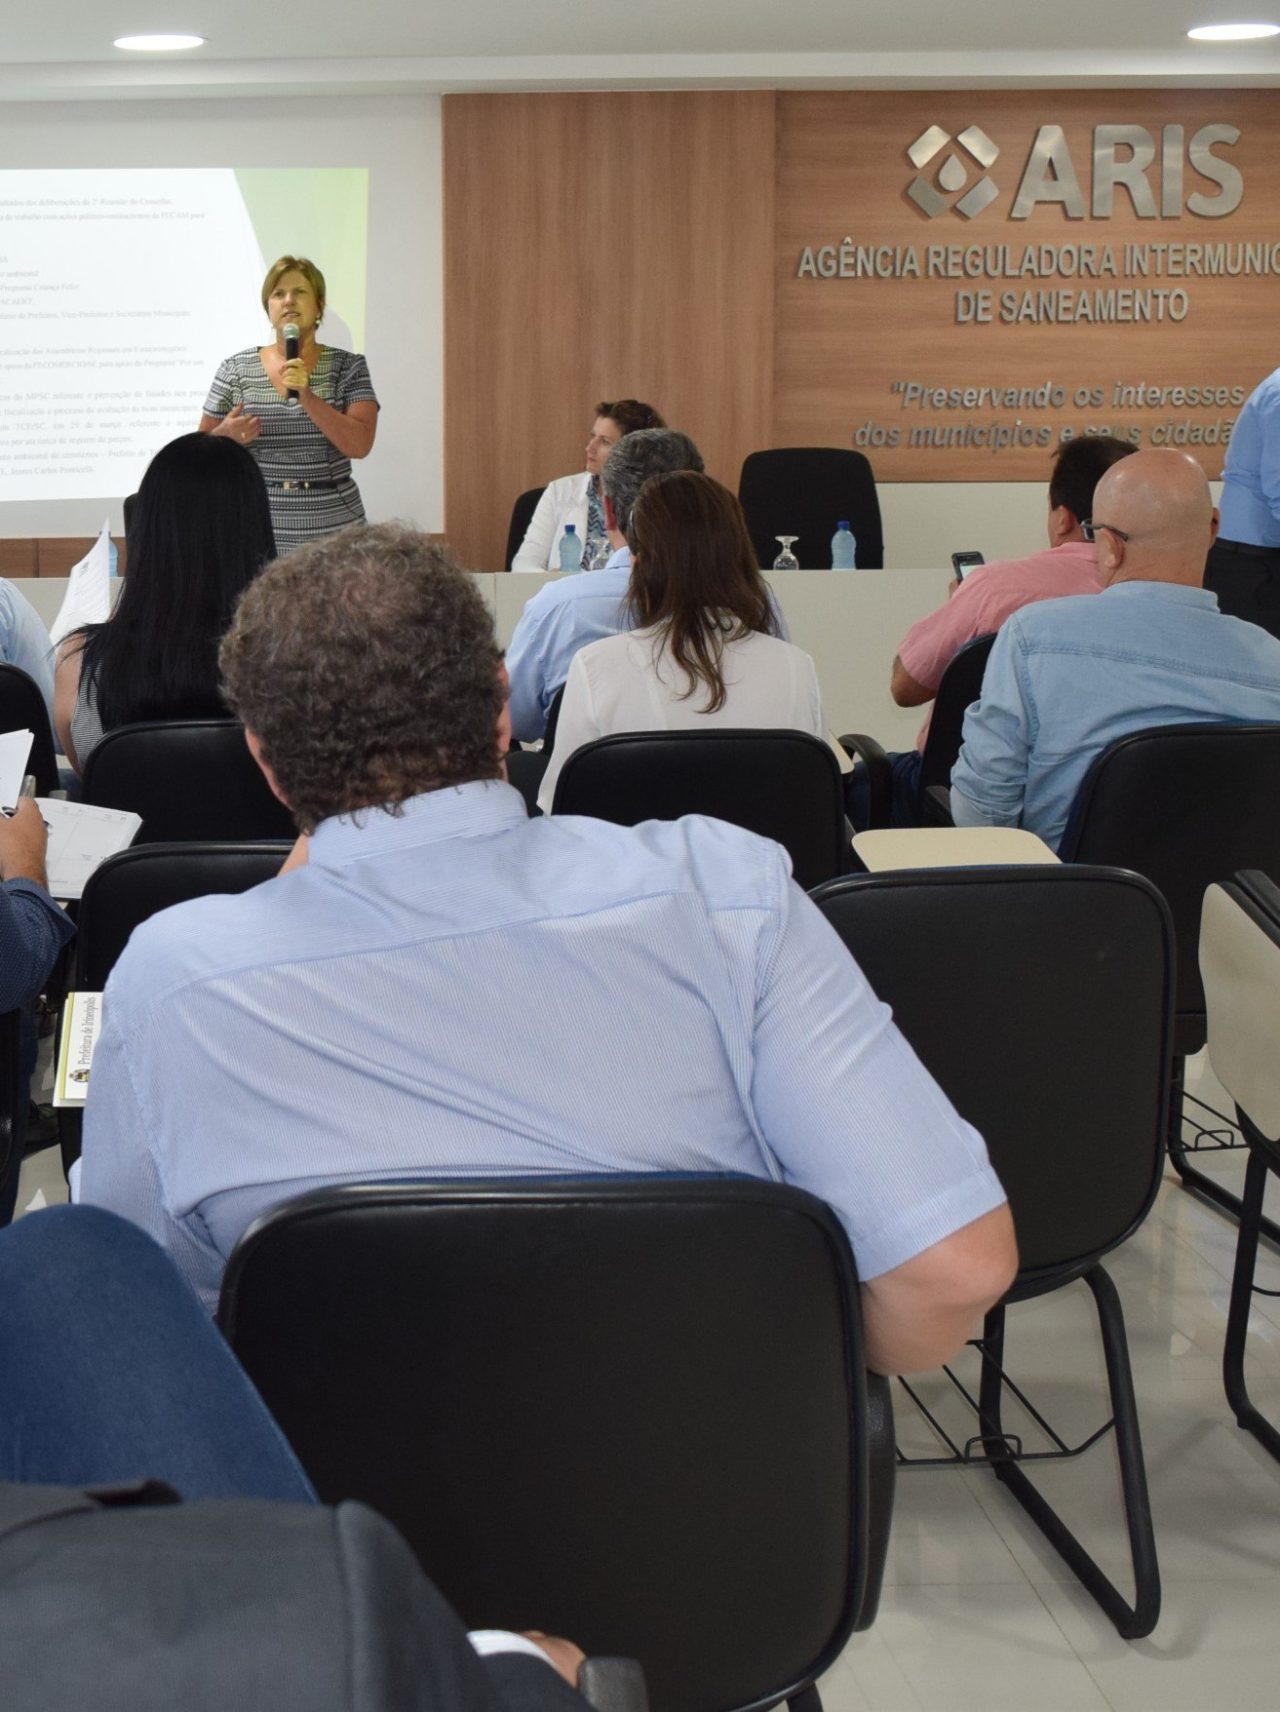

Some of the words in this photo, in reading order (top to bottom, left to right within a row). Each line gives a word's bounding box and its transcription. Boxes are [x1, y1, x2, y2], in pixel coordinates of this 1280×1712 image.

[1009, 123, 1245, 219] ARIS
[797, 236, 920, 278] AGÊNCIA
[927, 243, 1116, 278] REGULADORA
[957, 289, 993, 322] DE
[1000, 287, 1189, 322] SANEAMENTO
[893, 381, 1066, 408] "Preservando
[1073, 386, 1105, 407] os
[1113, 381, 1245, 408] interesses
[854, 420, 902, 447] dos
[909, 418, 1052, 454] municípios
[1060, 426, 1073, 444] e
